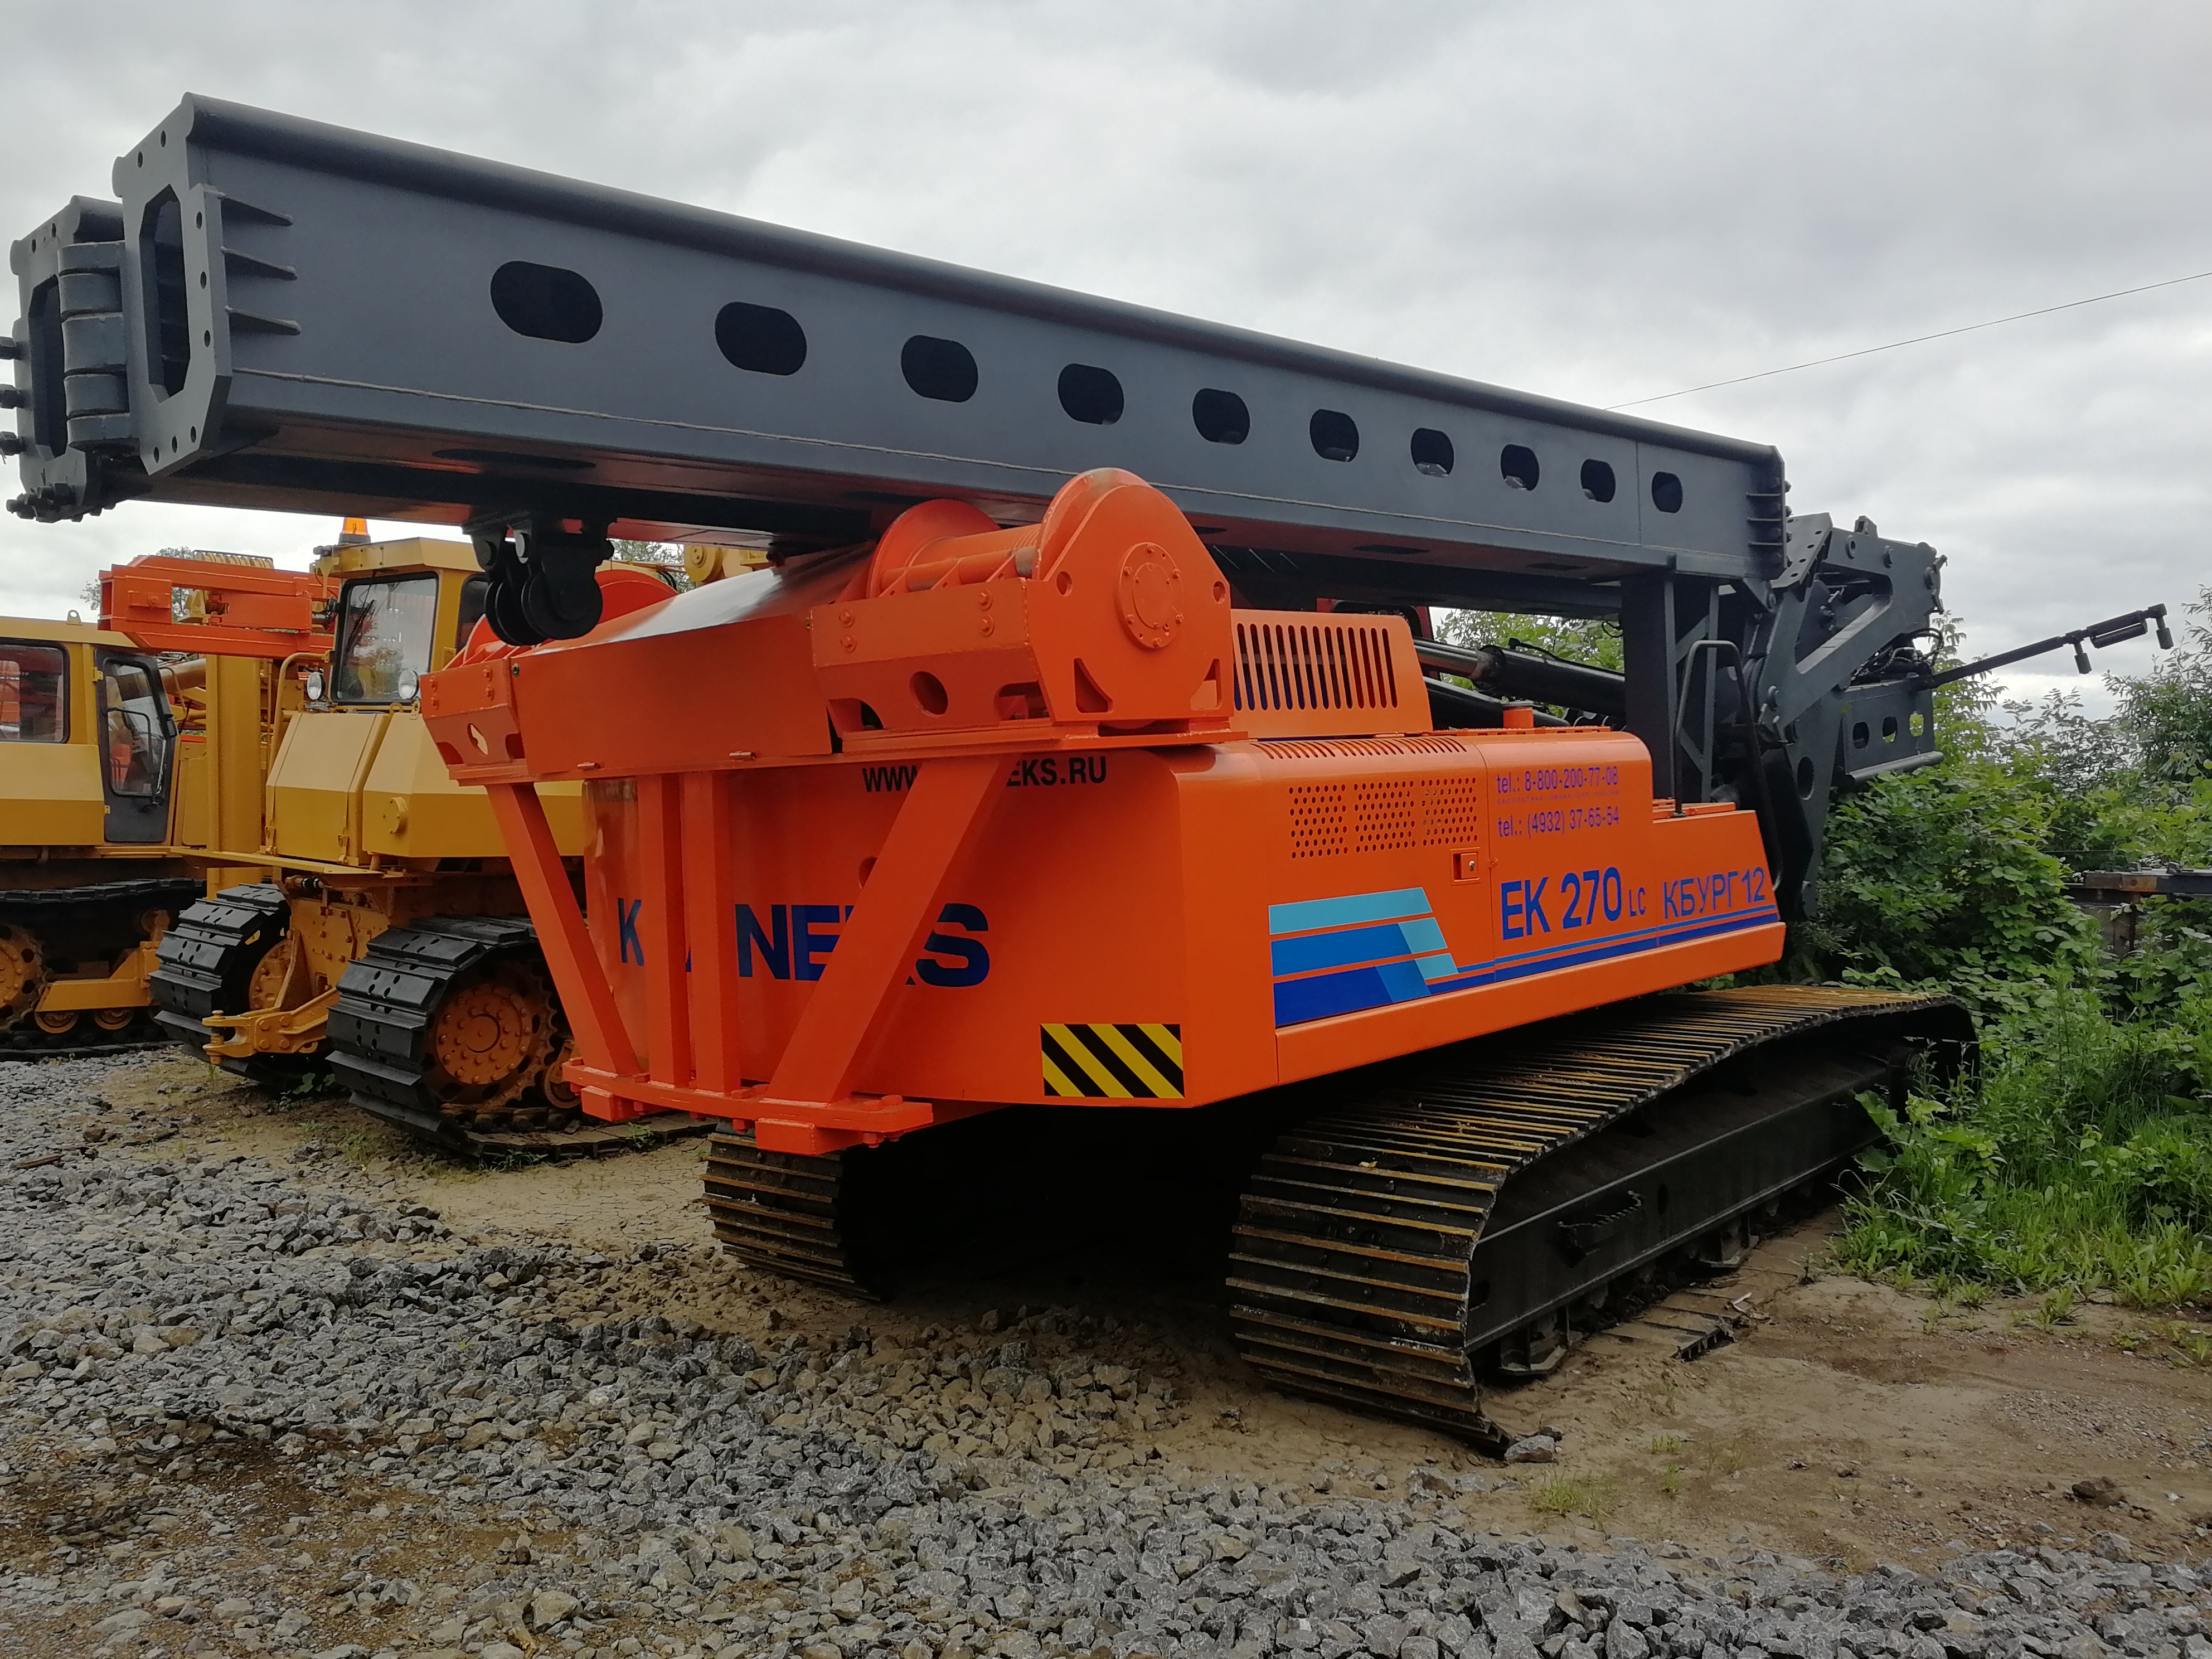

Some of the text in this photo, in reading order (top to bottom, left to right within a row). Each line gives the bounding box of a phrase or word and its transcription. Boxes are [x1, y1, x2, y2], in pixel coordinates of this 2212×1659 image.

[1496, 765, 1618, 794] tel.: 8-800-200-77-08
[1497, 806, 1619, 839] tel.: (4932) 37-65-54
[1500, 866, 1646, 940] EK 270 LC
[1663, 866, 1766, 919] КБУРГ12
[617, 898, 990, 987] KNES
